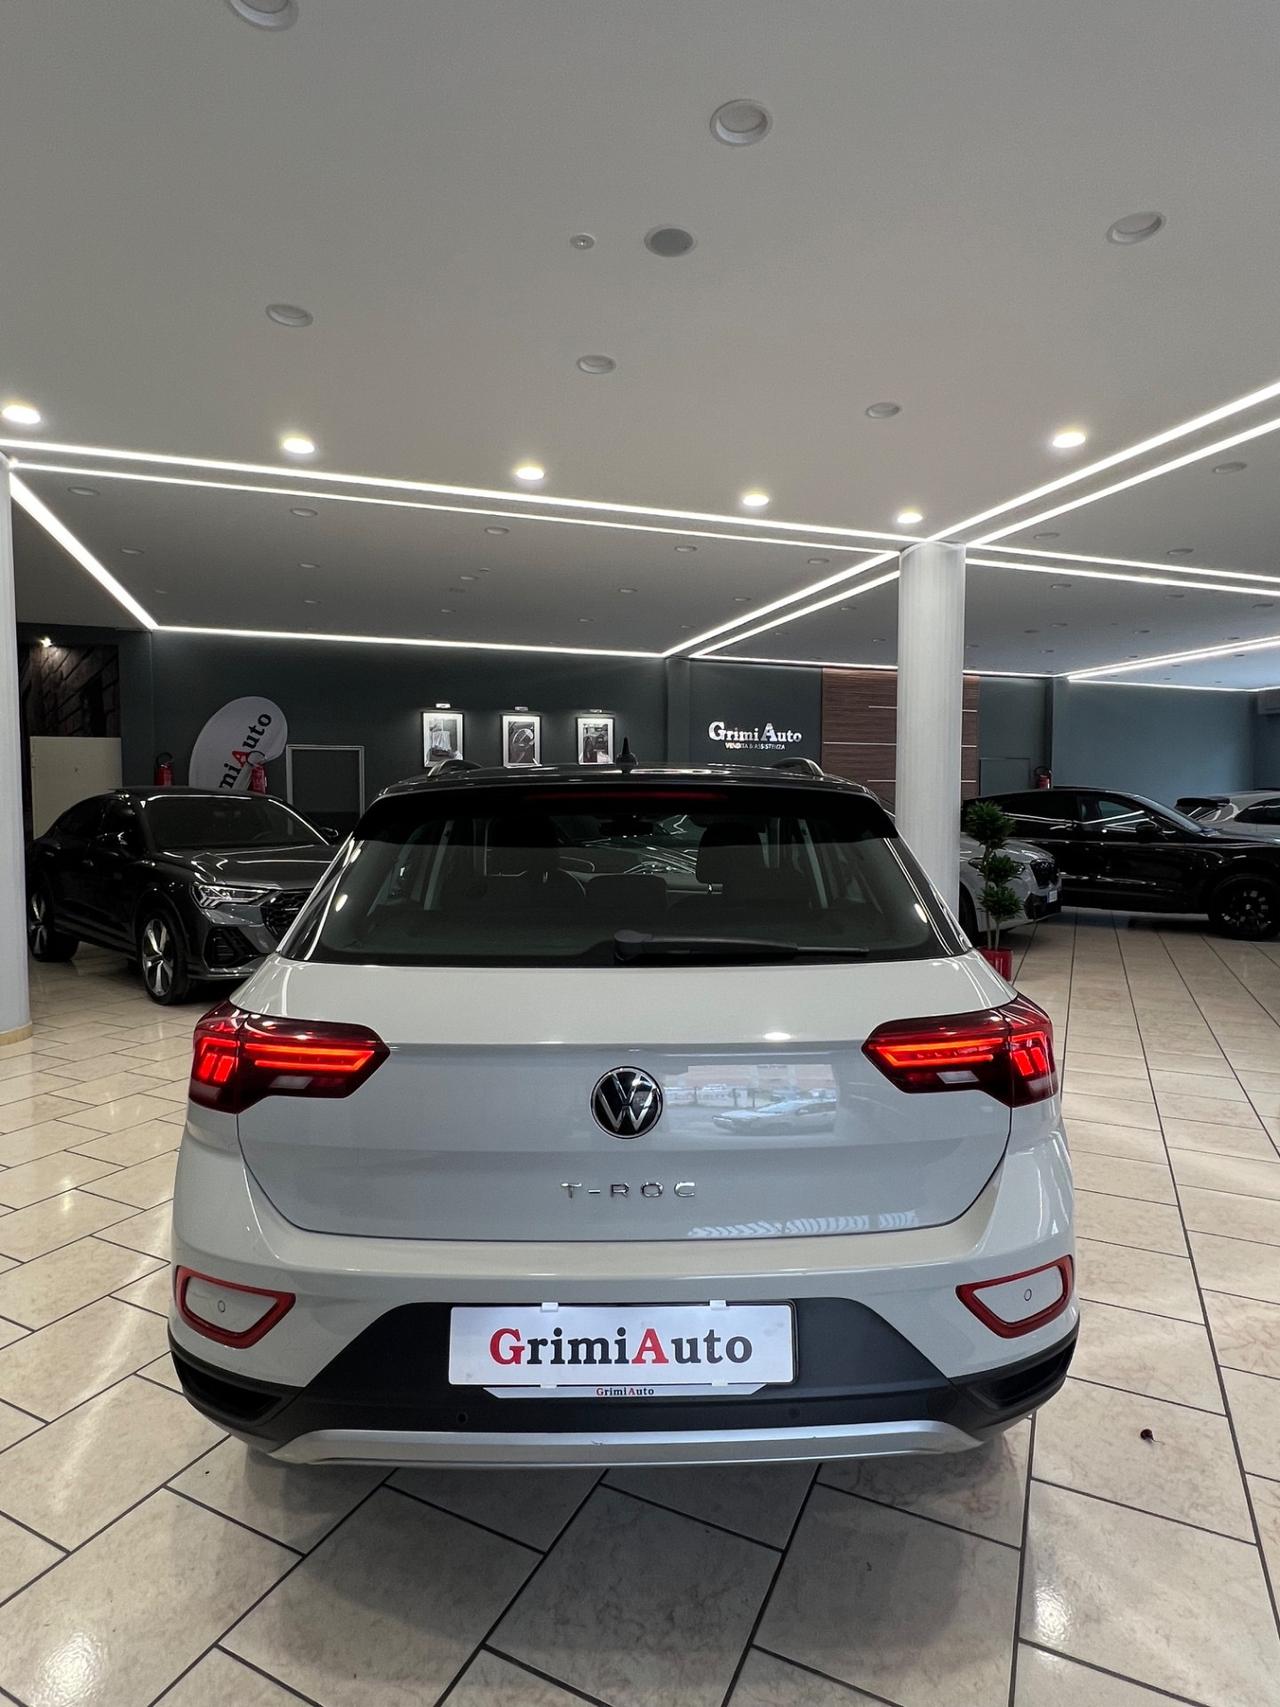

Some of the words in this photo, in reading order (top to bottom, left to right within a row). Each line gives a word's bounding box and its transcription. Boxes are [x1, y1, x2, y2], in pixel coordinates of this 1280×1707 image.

[708, 721, 759, 741] Grimi
[760, 722, 802, 742] Auto
[560, 1181, 697, 1199] T-ROC
[489, 1326, 753, 1365] GrimiAuto
[596, 1387, 655, 1396] GrimiAuto
